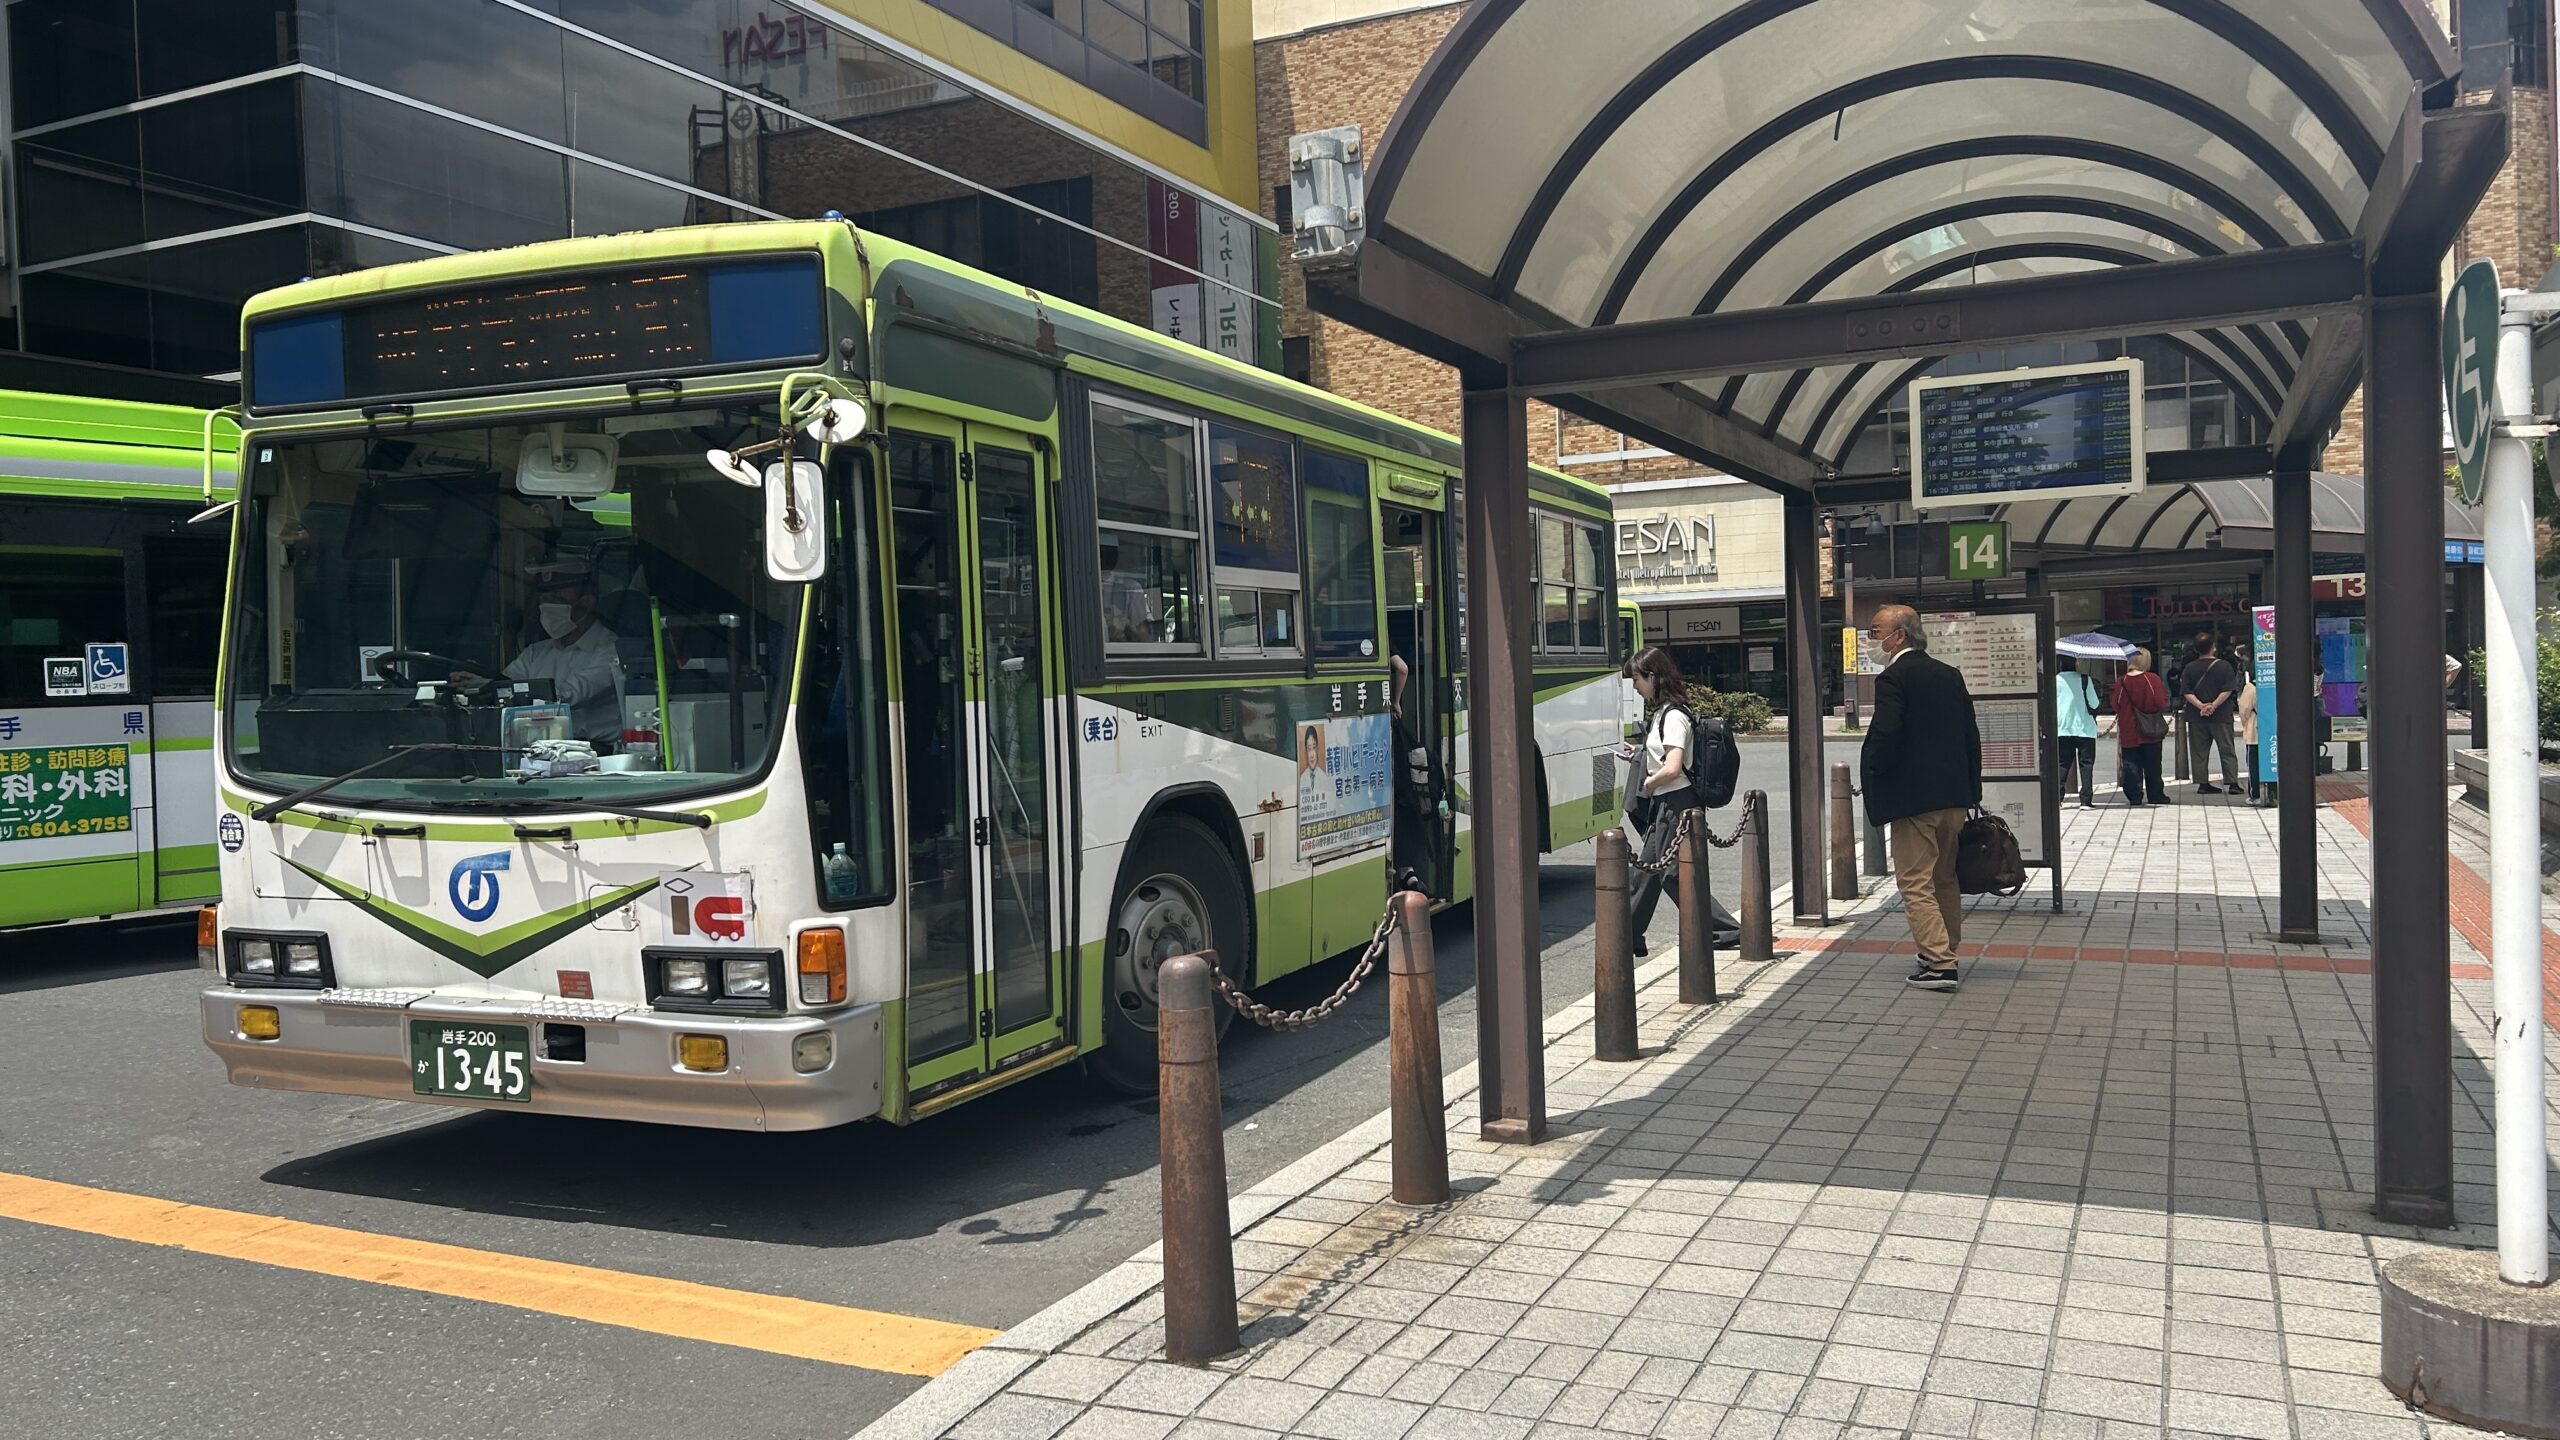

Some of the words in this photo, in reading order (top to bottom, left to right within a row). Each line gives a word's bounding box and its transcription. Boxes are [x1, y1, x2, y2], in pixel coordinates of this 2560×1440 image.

[1614, 513, 1714, 555] ESAN
[1953, 534, 1999, 571] 14
[1687, 619, 1721, 632] FESAN
[53, 666, 78, 676] NBA
[1135, 692, 1167, 721] 出口
[123, 711, 145, 735] 県
[1083, 714, 1119, 744] (乗合)
[1141, 725, 1163, 738] EXIT
[1, 767, 129, 805] 科・外科
[30, 815, 130, 837] 604-3755
[416, 1058, 430, 1076] か
[436, 1046, 525, 1096] 13-45
